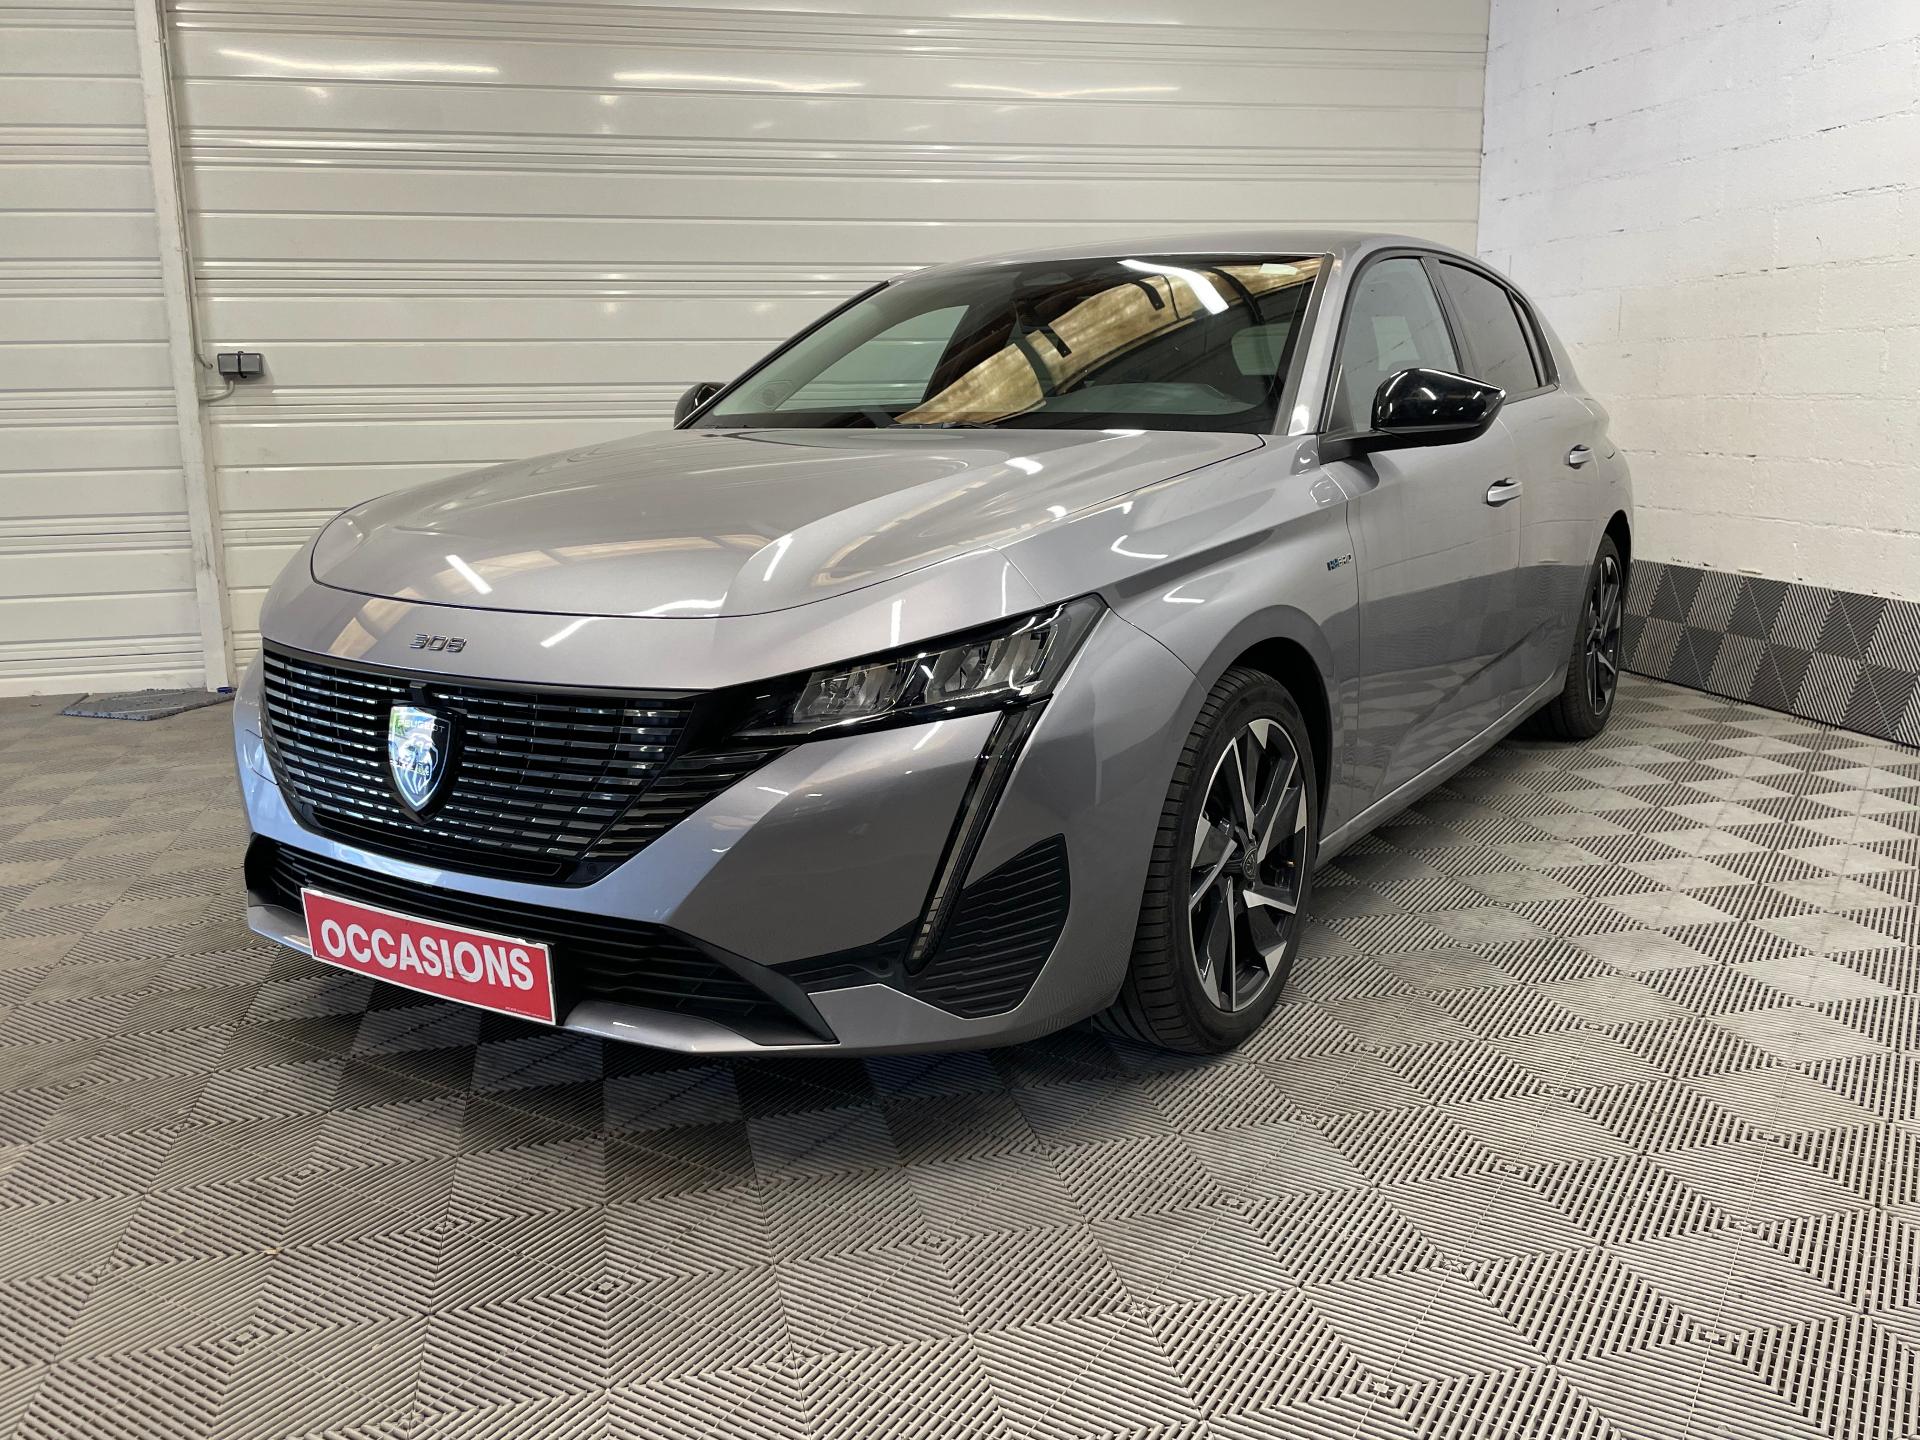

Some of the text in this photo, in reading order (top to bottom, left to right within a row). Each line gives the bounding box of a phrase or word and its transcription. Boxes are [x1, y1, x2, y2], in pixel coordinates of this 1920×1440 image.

[409, 634, 467, 653] 308
[397, 720, 446, 733] PEUGEOT
[321, 919, 534, 990] OCCASIONS
